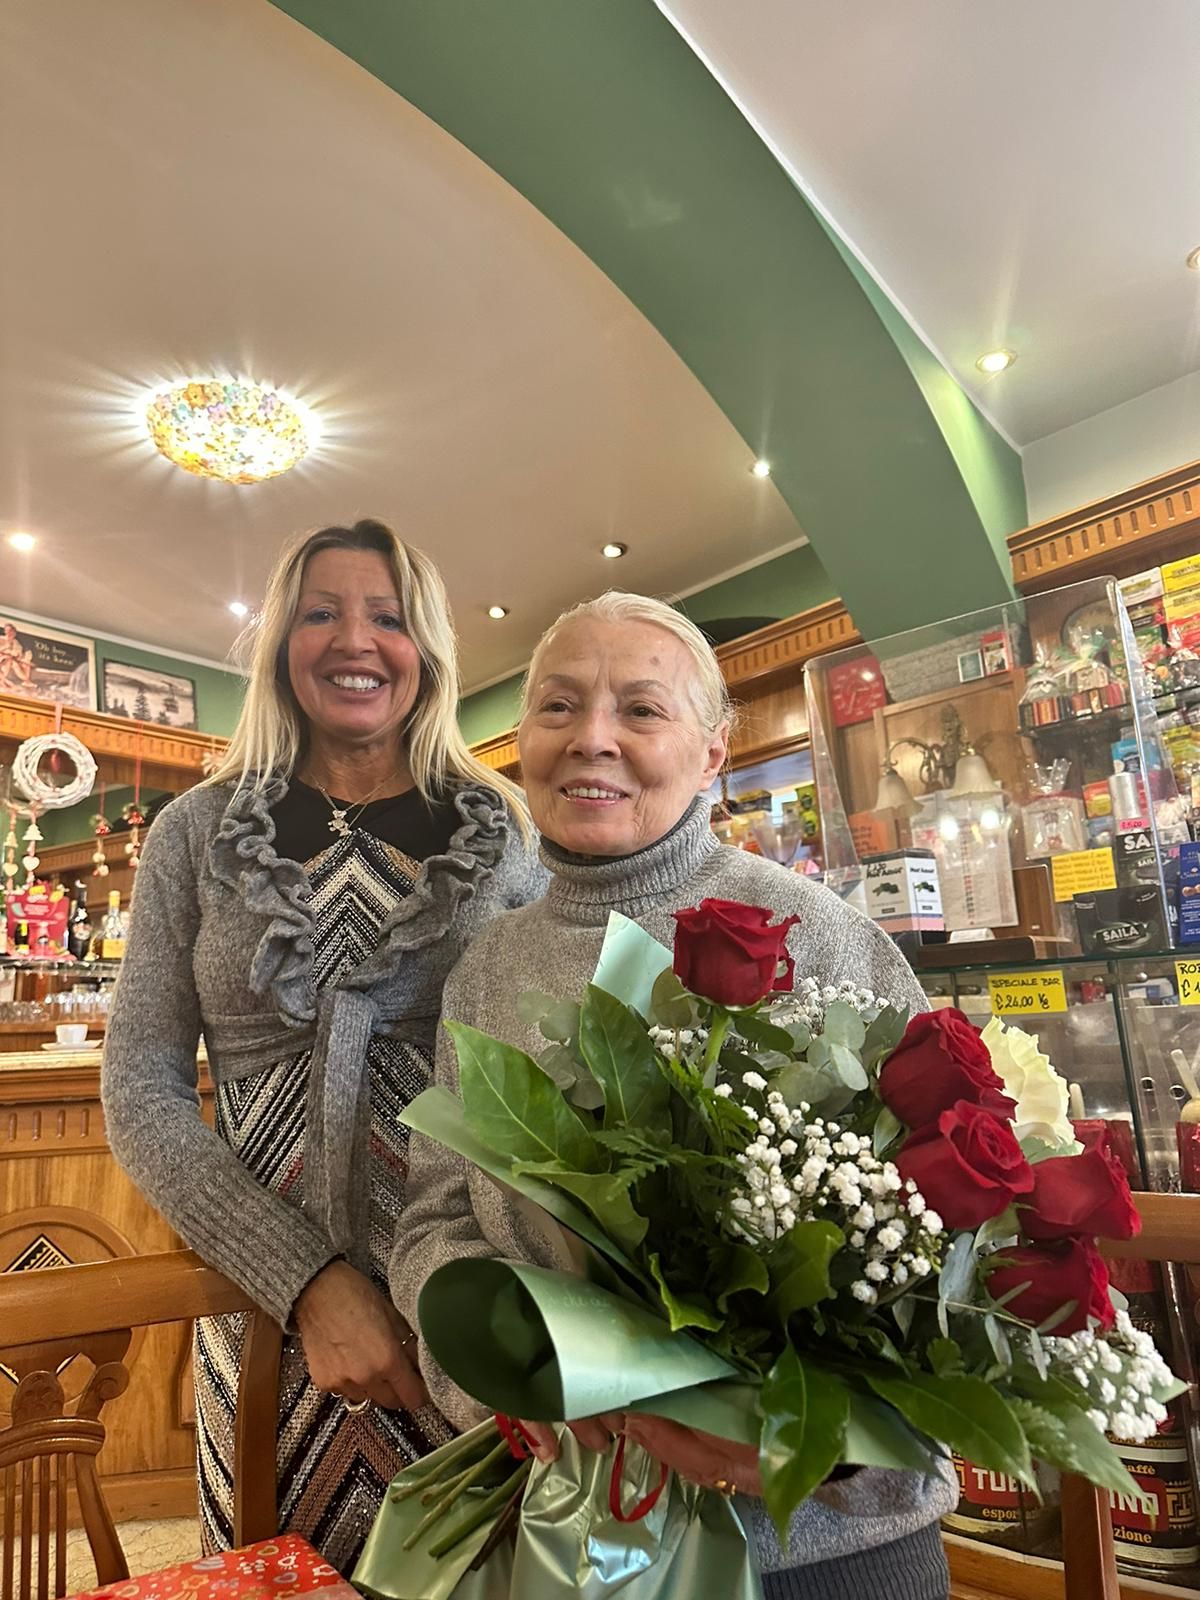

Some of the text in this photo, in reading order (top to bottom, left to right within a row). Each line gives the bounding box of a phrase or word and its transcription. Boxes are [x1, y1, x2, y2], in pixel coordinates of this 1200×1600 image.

[1102, 926, 1140, 941] SAILA
[991, 977, 1061, 988] SPECIALE BAR
[1127, 1464, 1156, 1475] affè
[1109, 1490, 1160, 1516] INO
